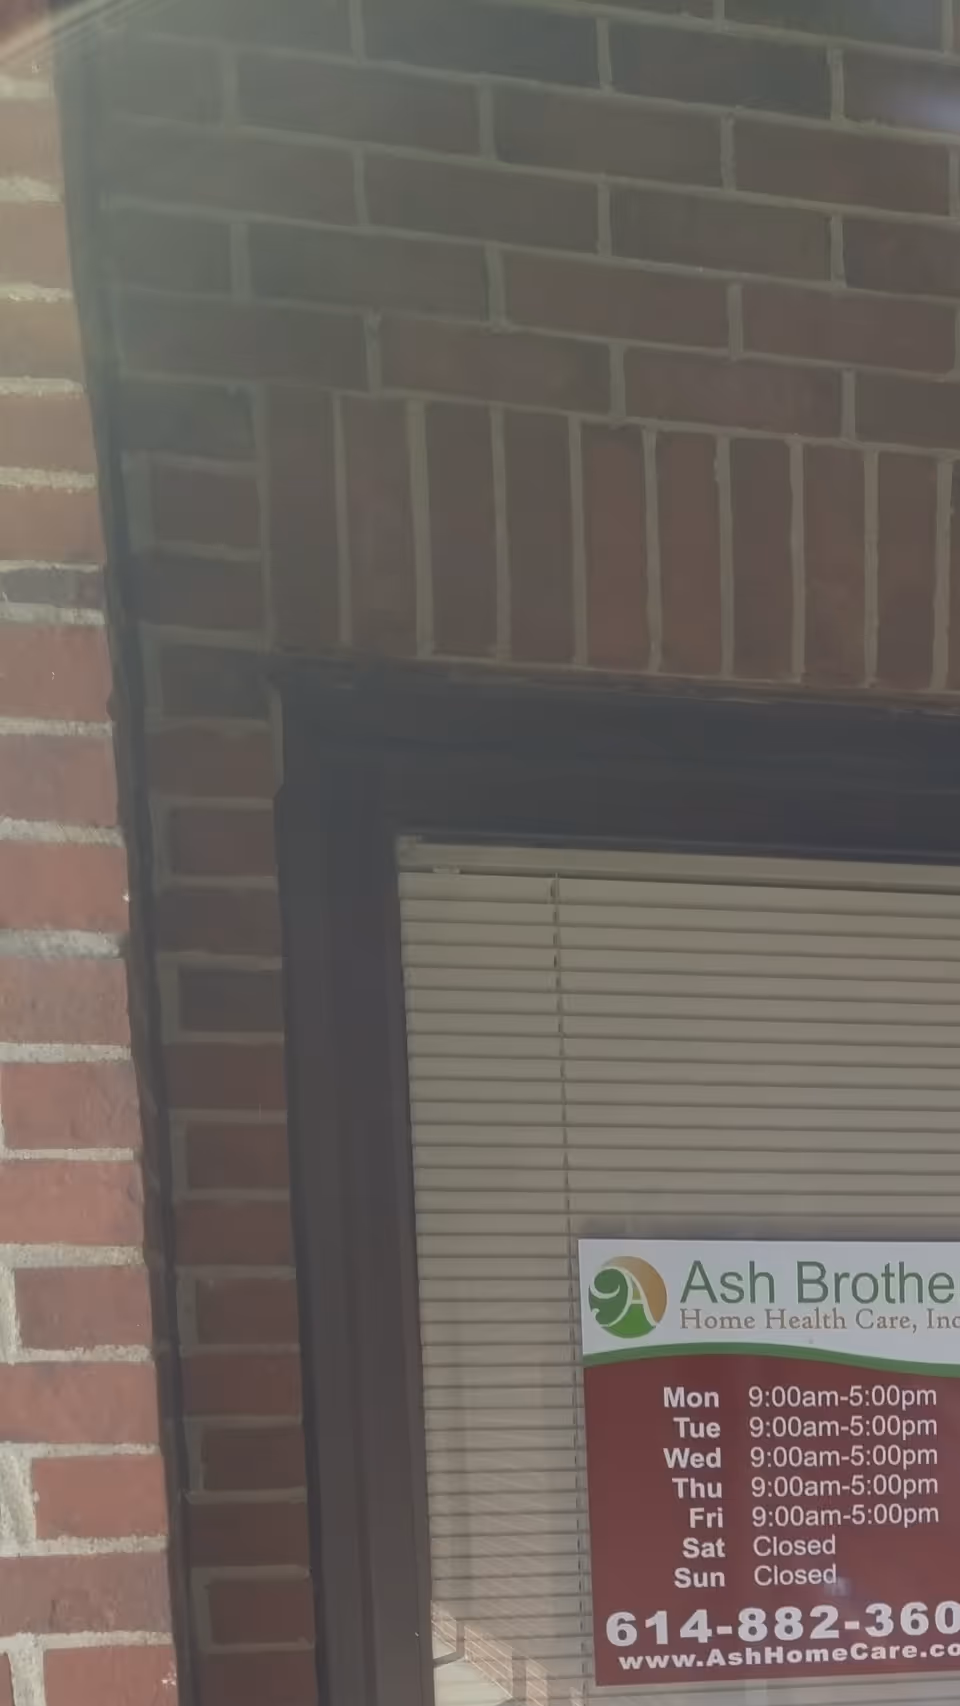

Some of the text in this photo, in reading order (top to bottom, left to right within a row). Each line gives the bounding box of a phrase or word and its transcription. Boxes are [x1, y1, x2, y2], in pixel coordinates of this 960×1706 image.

[680, 1260, 775, 1304] Ash
[679, 1308, 756, 1330] Home
[764, 1307, 847, 1330] Health
[855, 1308, 918, 1334] Care,
[663, 1384, 937, 1411] Mon 9:00am-5:00pm
[673, 1415, 938, 1441] Tue 9:00am-5:00pm
[663, 1444, 938, 1470] Wed 9:00am-5:00pm
[672, 1473, 939, 1499] Thu 9:00am-5:00pm
[689, 1503, 939, 1529] Fri 9:00am-5:00pm
[682, 1534, 836, 1559] Sat Closed
[674, 1563, 837, 1589] Sun Closed
